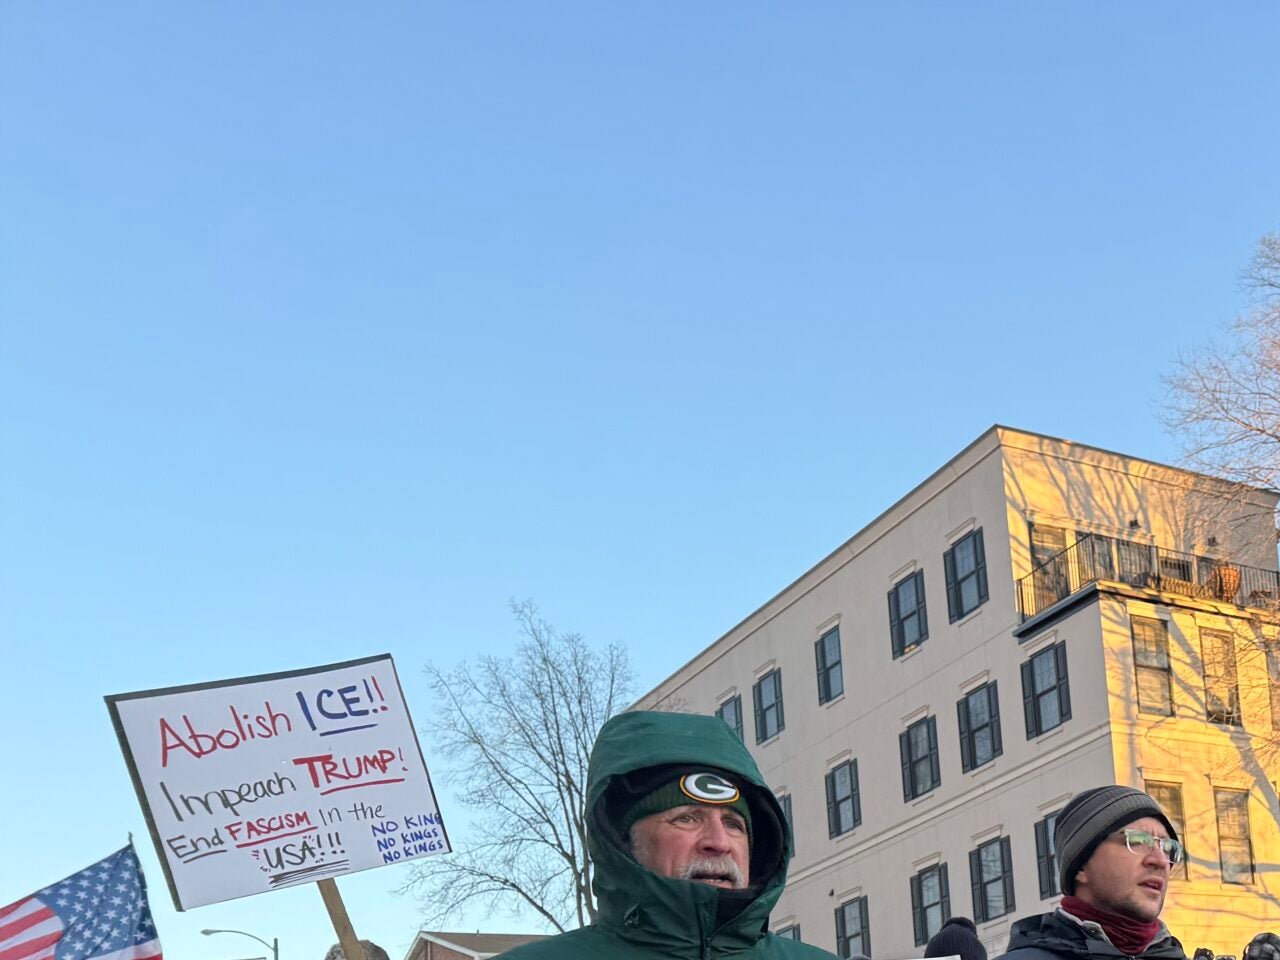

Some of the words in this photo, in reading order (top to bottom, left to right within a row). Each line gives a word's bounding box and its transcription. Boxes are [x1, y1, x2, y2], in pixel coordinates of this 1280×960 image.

[160, 701, 292, 768] Abolish
[296, 676, 389, 731] ICE!!
[160, 772, 296, 822] Impeach
[293, 747, 408, 788] TRUMP!
[166, 828, 225, 859] End
[225, 811, 312, 841] FASCISM
[347, 802, 386, 821] the
[371, 821, 398, 837] NO
[376, 837, 396, 852] NO
[401, 828, 438, 844] KINGS
[263, 832, 346, 870] USA!!!
[382, 851, 401, 864] NO
[403, 840, 443, 857] KINGS
